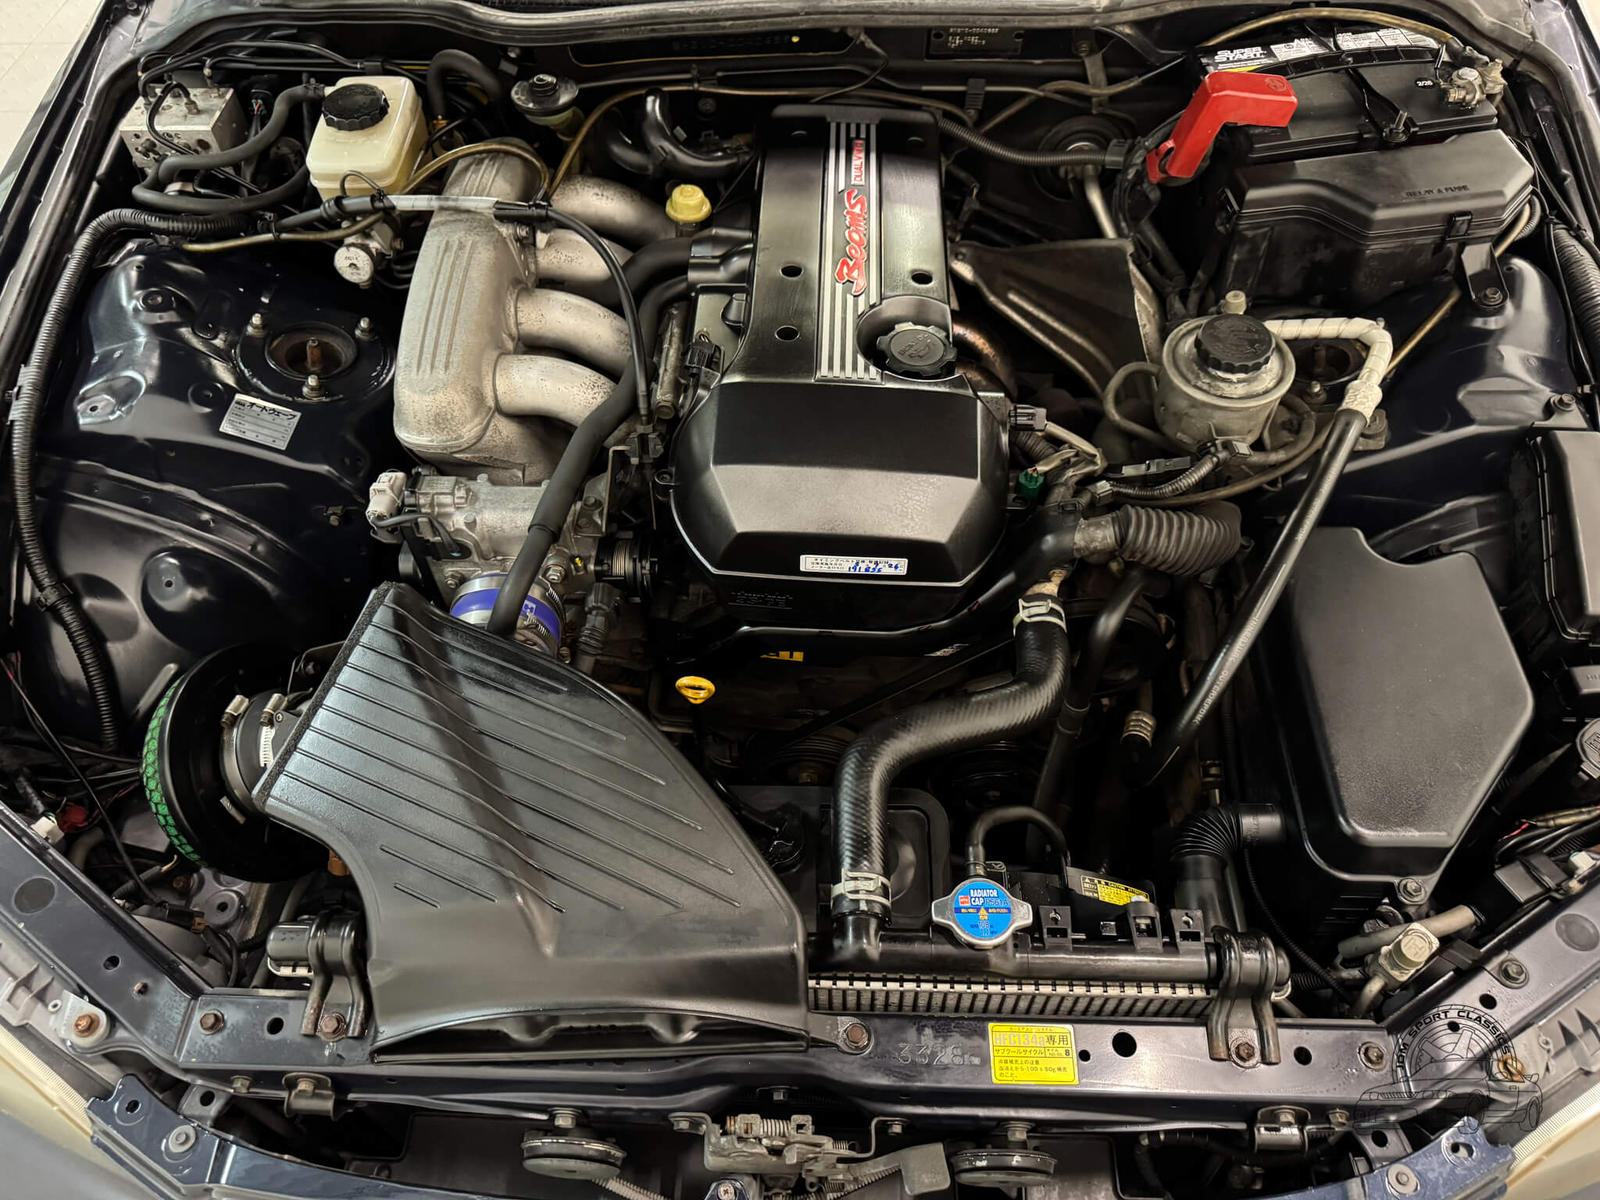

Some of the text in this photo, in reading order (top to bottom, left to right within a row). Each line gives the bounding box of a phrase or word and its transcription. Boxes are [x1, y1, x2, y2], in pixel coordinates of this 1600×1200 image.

[1216, 46, 1262, 56] SUPER
[853, 160, 863, 182] DUAL
[969, 889, 998, 898] RADIATOR
[970, 897, 984, 906] CAP
[994, 1031, 1069, 1047] HFC134a 専用
[1064, 1049, 1071, 1057] 8
